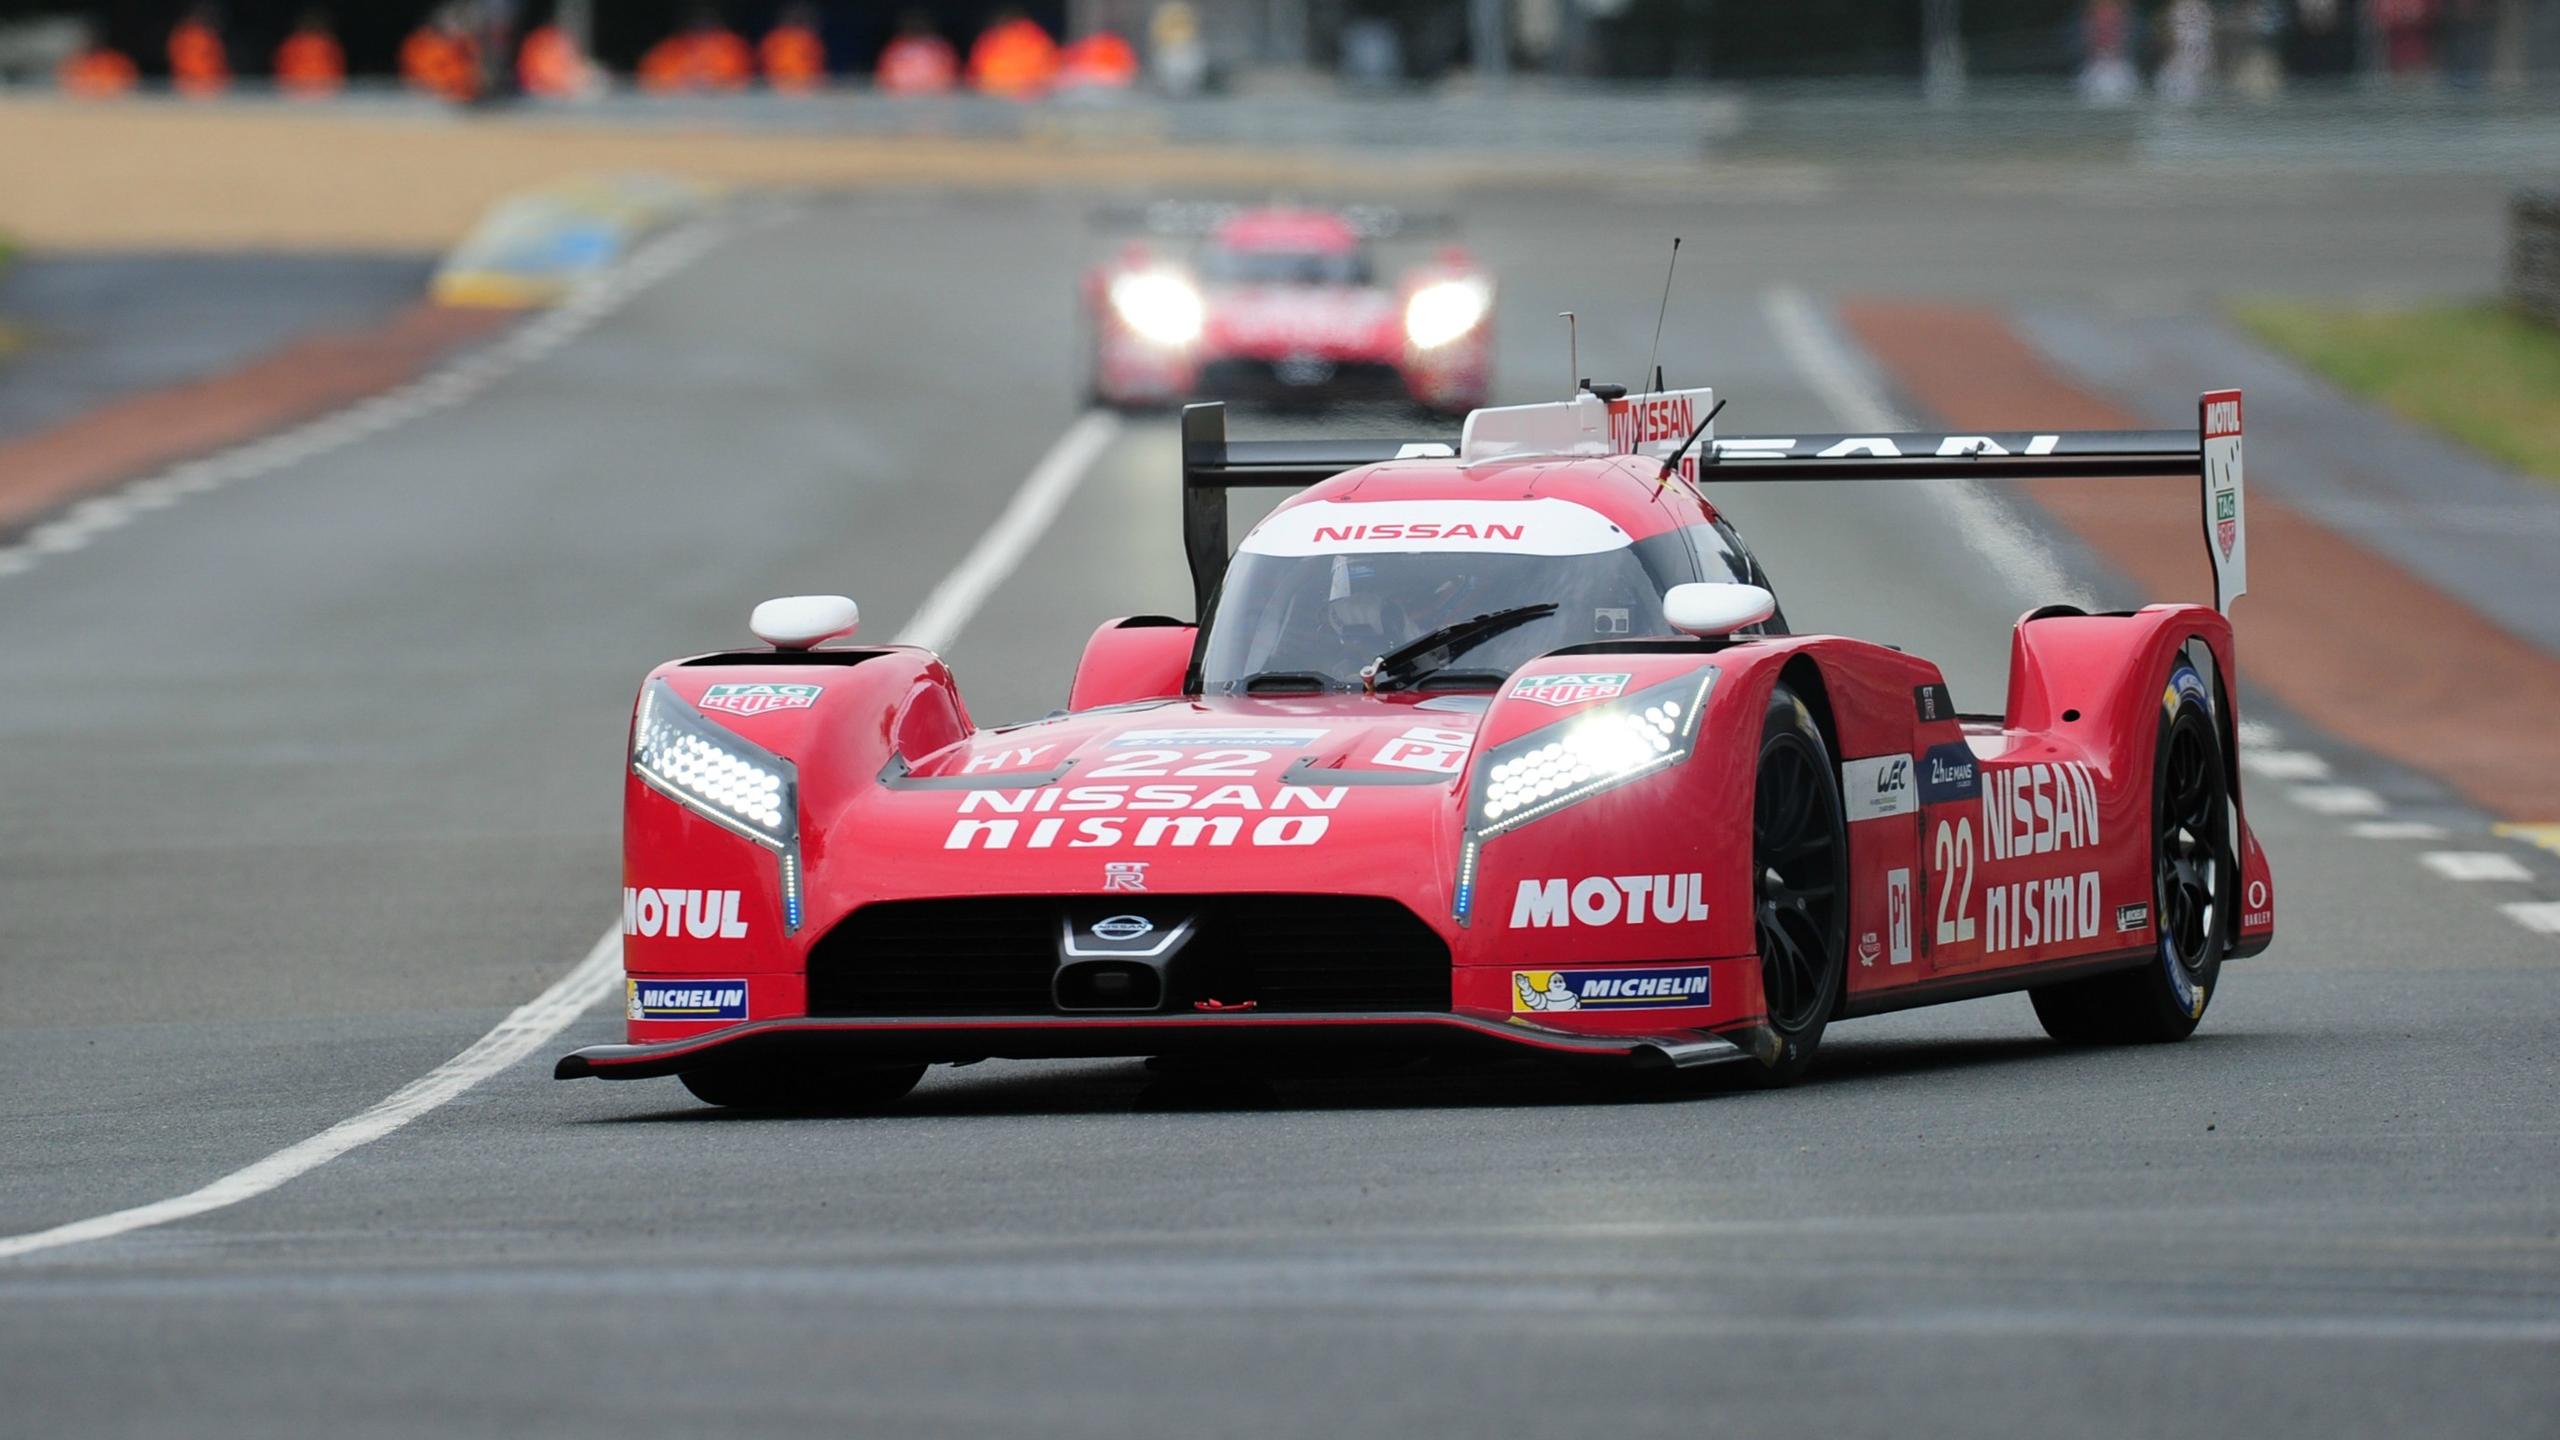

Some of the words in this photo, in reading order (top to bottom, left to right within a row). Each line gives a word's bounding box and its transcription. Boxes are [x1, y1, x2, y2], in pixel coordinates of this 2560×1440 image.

[1632, 398, 1694, 443] NISSAN
[2206, 401, 2240, 434] MOTUL
[2218, 498, 2234, 517] TAG
[1313, 524, 1524, 542] NISSAN
[719, 685, 810, 695] TAG
[1515, 685, 1620, 702] HEUER
[1525, 675, 1617, 685] TAG
[706, 695, 810, 712] HEUER
[962, 744, 1056, 773] HY
[1085, 749, 1273, 777] 22
[1391, 743, 1465, 768] P1
[1877, 760, 1907, 793] WEC
[956, 785, 1350, 814] NISSAN
[1982, 760, 2099, 863] NISSAN
[943, 816, 1330, 850] nismo
[1103, 872, 1148, 890] R
[1105, 862, 1150, 873] GT
[1935, 817, 1975, 946] 22
[623, 887, 748, 939] MOTUL
[1509, 873, 1709, 928] MOTUL
[1986, 871, 2100, 953] nismo
[1892, 883, 1908, 950] P1
[643, 989, 743, 1007] MICHELIN
[1581, 976, 1707, 998] MICHELIN
